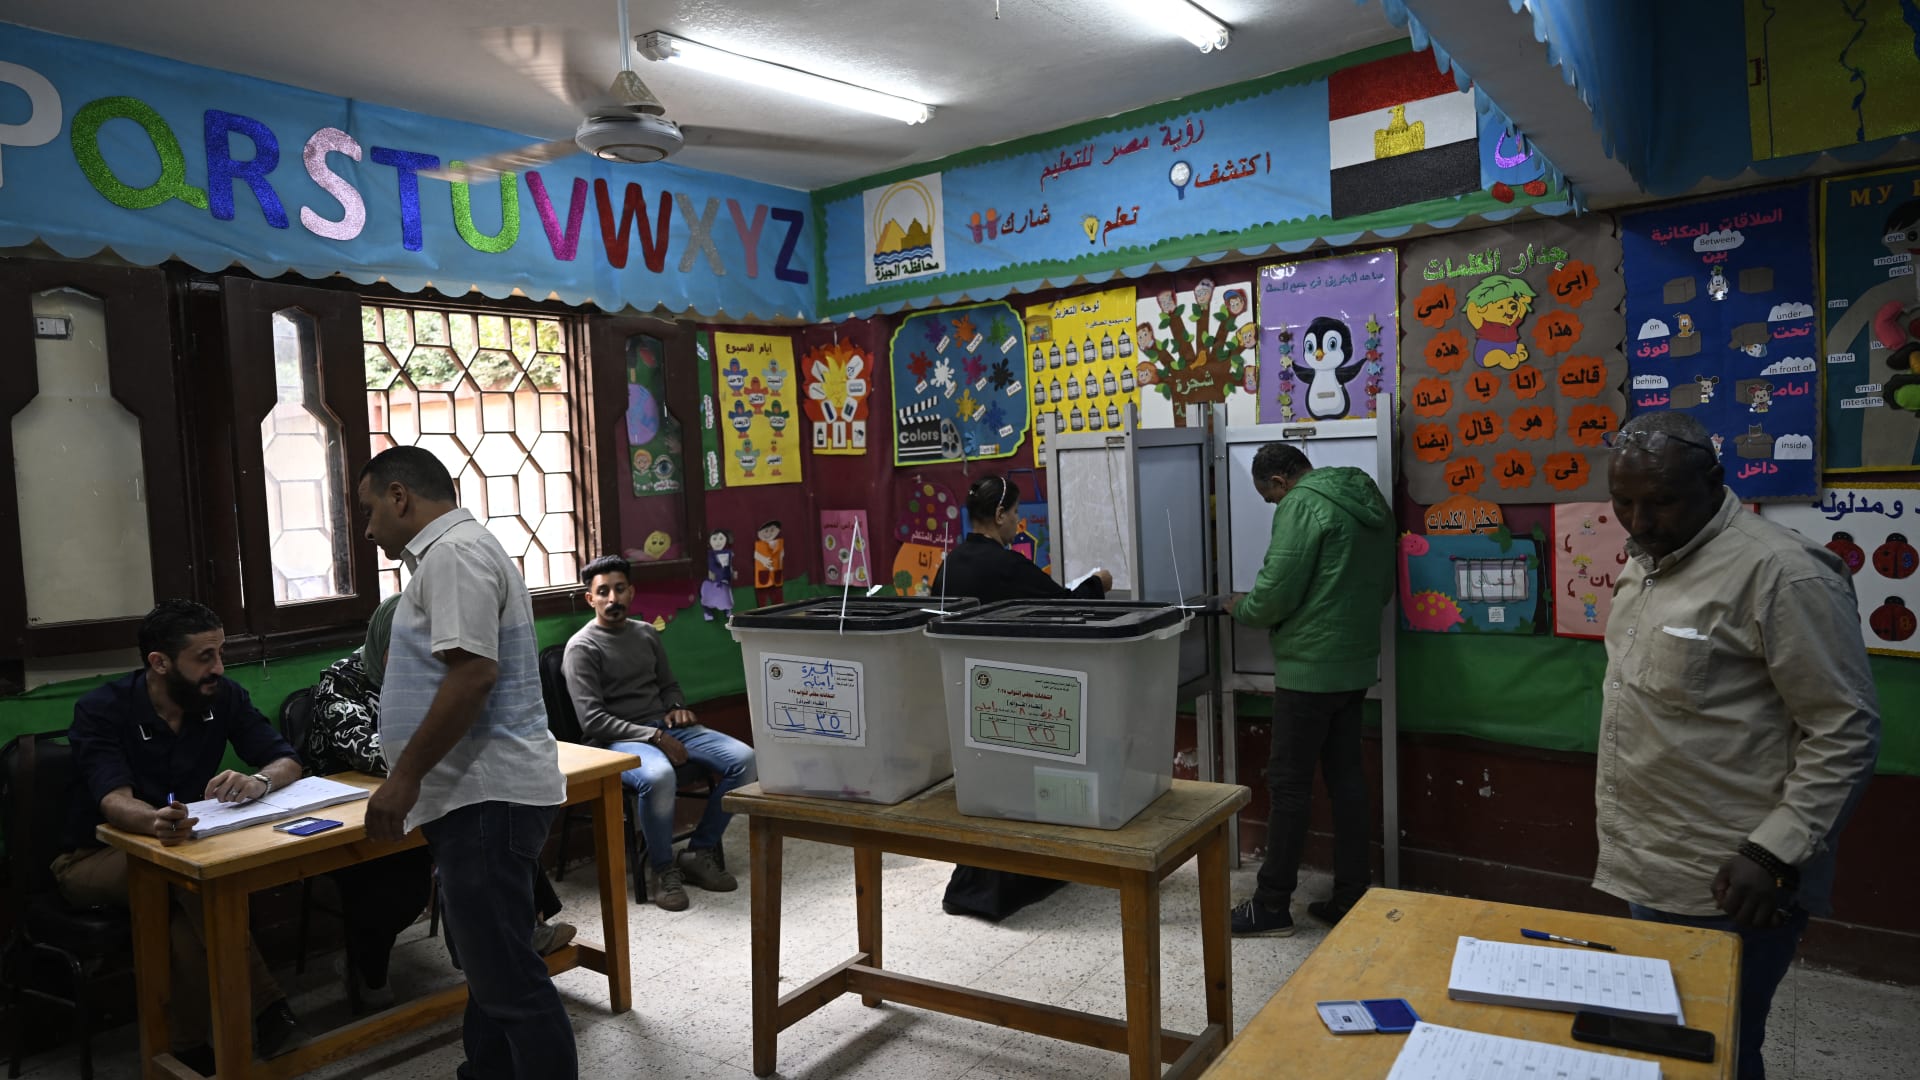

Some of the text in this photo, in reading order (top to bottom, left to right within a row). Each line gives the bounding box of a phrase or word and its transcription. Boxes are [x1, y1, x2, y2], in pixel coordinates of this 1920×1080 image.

[1039, 118, 1205, 191] رؤية مصر للتعليم
[1194, 151, 1270, 188] اكتشف
[1001, 203, 1051, 235] شارك
[1102, 206, 1140, 247] تعلم
[1699, 235, 1736, 247] Between
[1886, 232, 1905, 242] eye
[1508, 243, 1569, 272] جدار
[1702, 250, 1728, 264] بين
[1877, 253, 1909, 265] mouth
[875, 259, 939, 281] محافظة الجيزة
[1890, 265, 1913, 277] neck
[1829, 299, 1848, 308] arm
[1776, 310, 1802, 320] under
[1548, 322, 1573, 340] هذا
[1649, 322, 1660, 330] on
[1772, 321, 1814, 339] تحت
[1435, 343, 1459, 358] هذه
[1636, 338, 1670, 358] فوق
[1829, 352, 1853, 362] hand
[1561, 366, 1600, 385] قالت
[1779, 364, 1800, 373] front
[1474, 377, 1490, 396] يا
[1635, 376, 1662, 386] behind
[1416, 388, 1447, 407] لماذا
[1636, 391, 1670, 408] خلف
[1841, 396, 1883, 407] intestine
[1465, 417, 1494, 440] قال
[1519, 414, 1542, 430] هو
[1578, 415, 1607, 436] نعم
[899, 429, 940, 444] Colors
[1781, 440, 1807, 450] inside
[1504, 459, 1525, 478] هل
[1736, 461, 1779, 479] داخل
[1427, 507, 1498, 533] تحليل الكلمات
